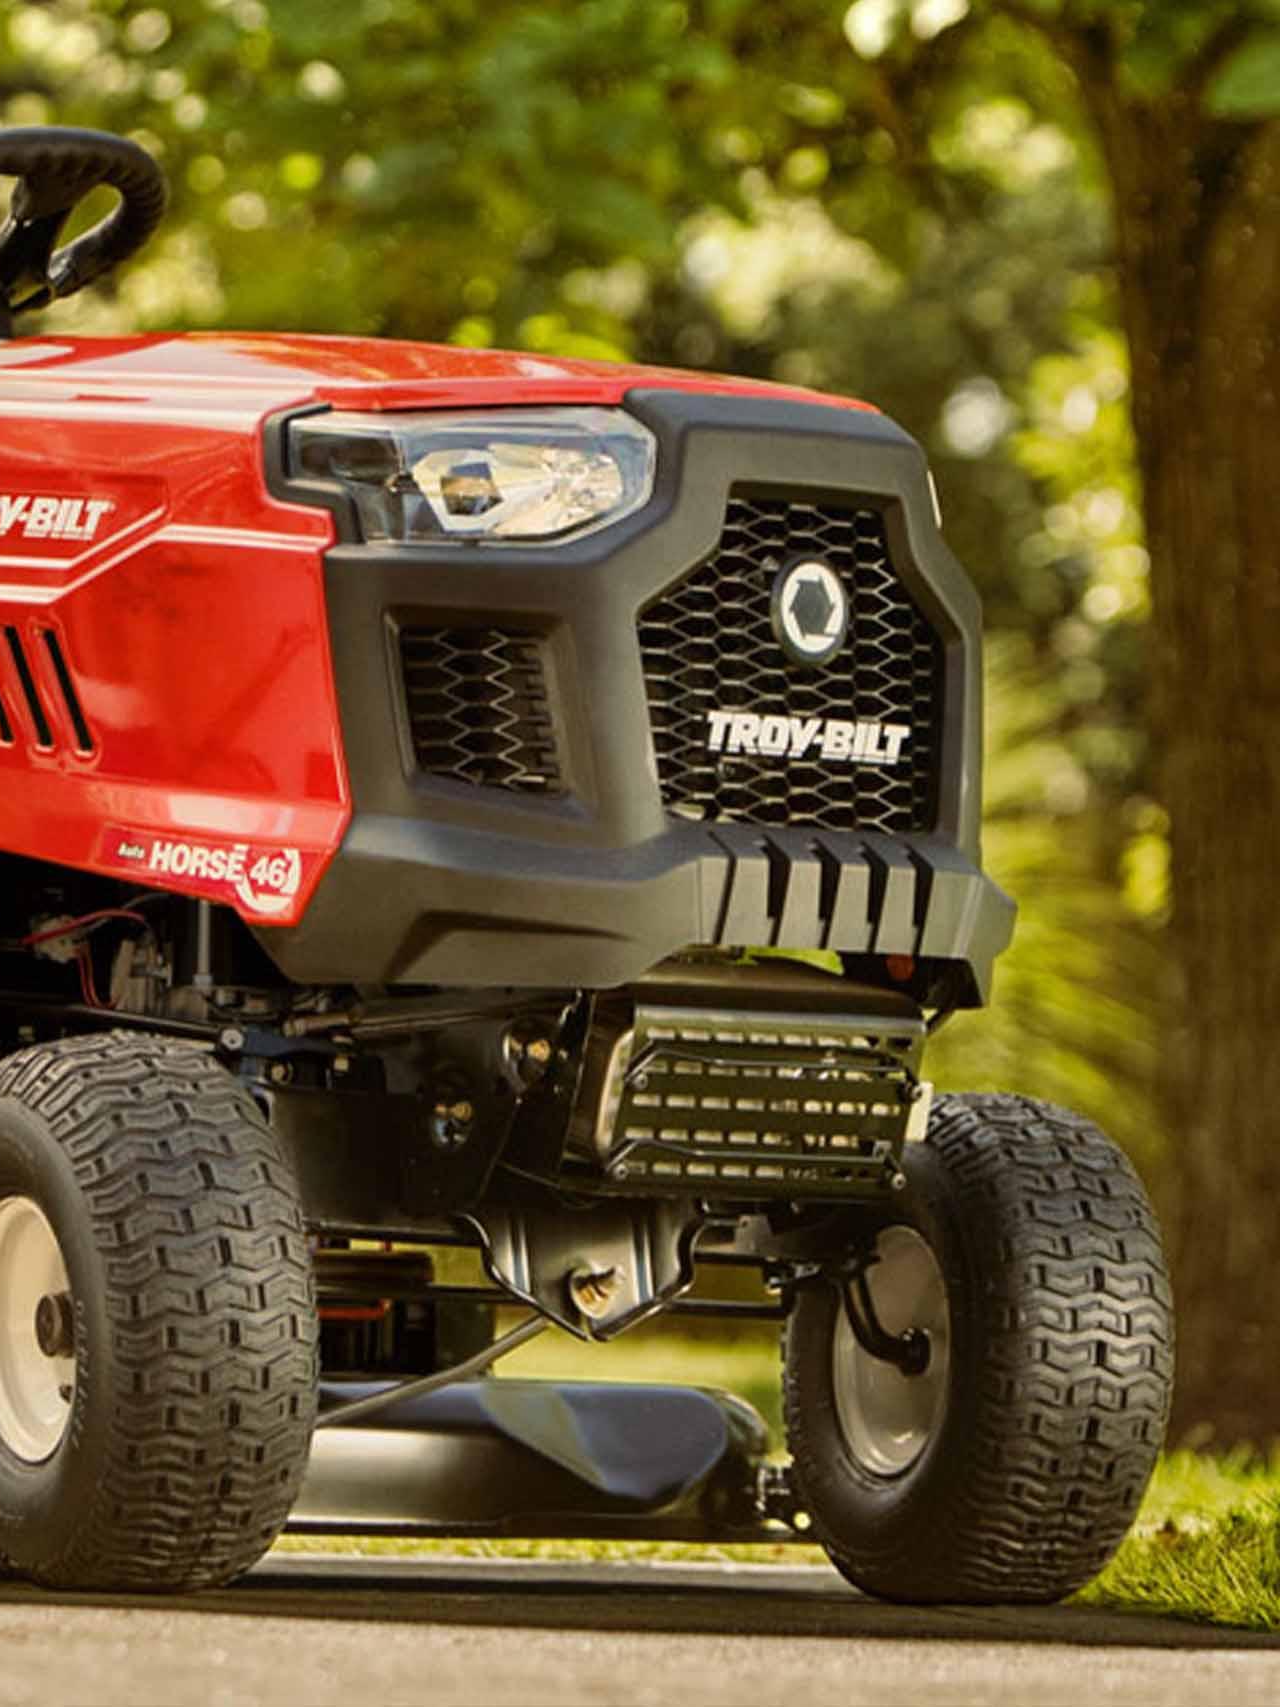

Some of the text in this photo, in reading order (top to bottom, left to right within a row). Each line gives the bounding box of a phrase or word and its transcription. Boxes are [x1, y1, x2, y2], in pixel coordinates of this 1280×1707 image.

[707, 711, 910, 765] TROY-BILT
[149, 841, 247, 881] HORSE
[250, 856, 286, 888] 46
